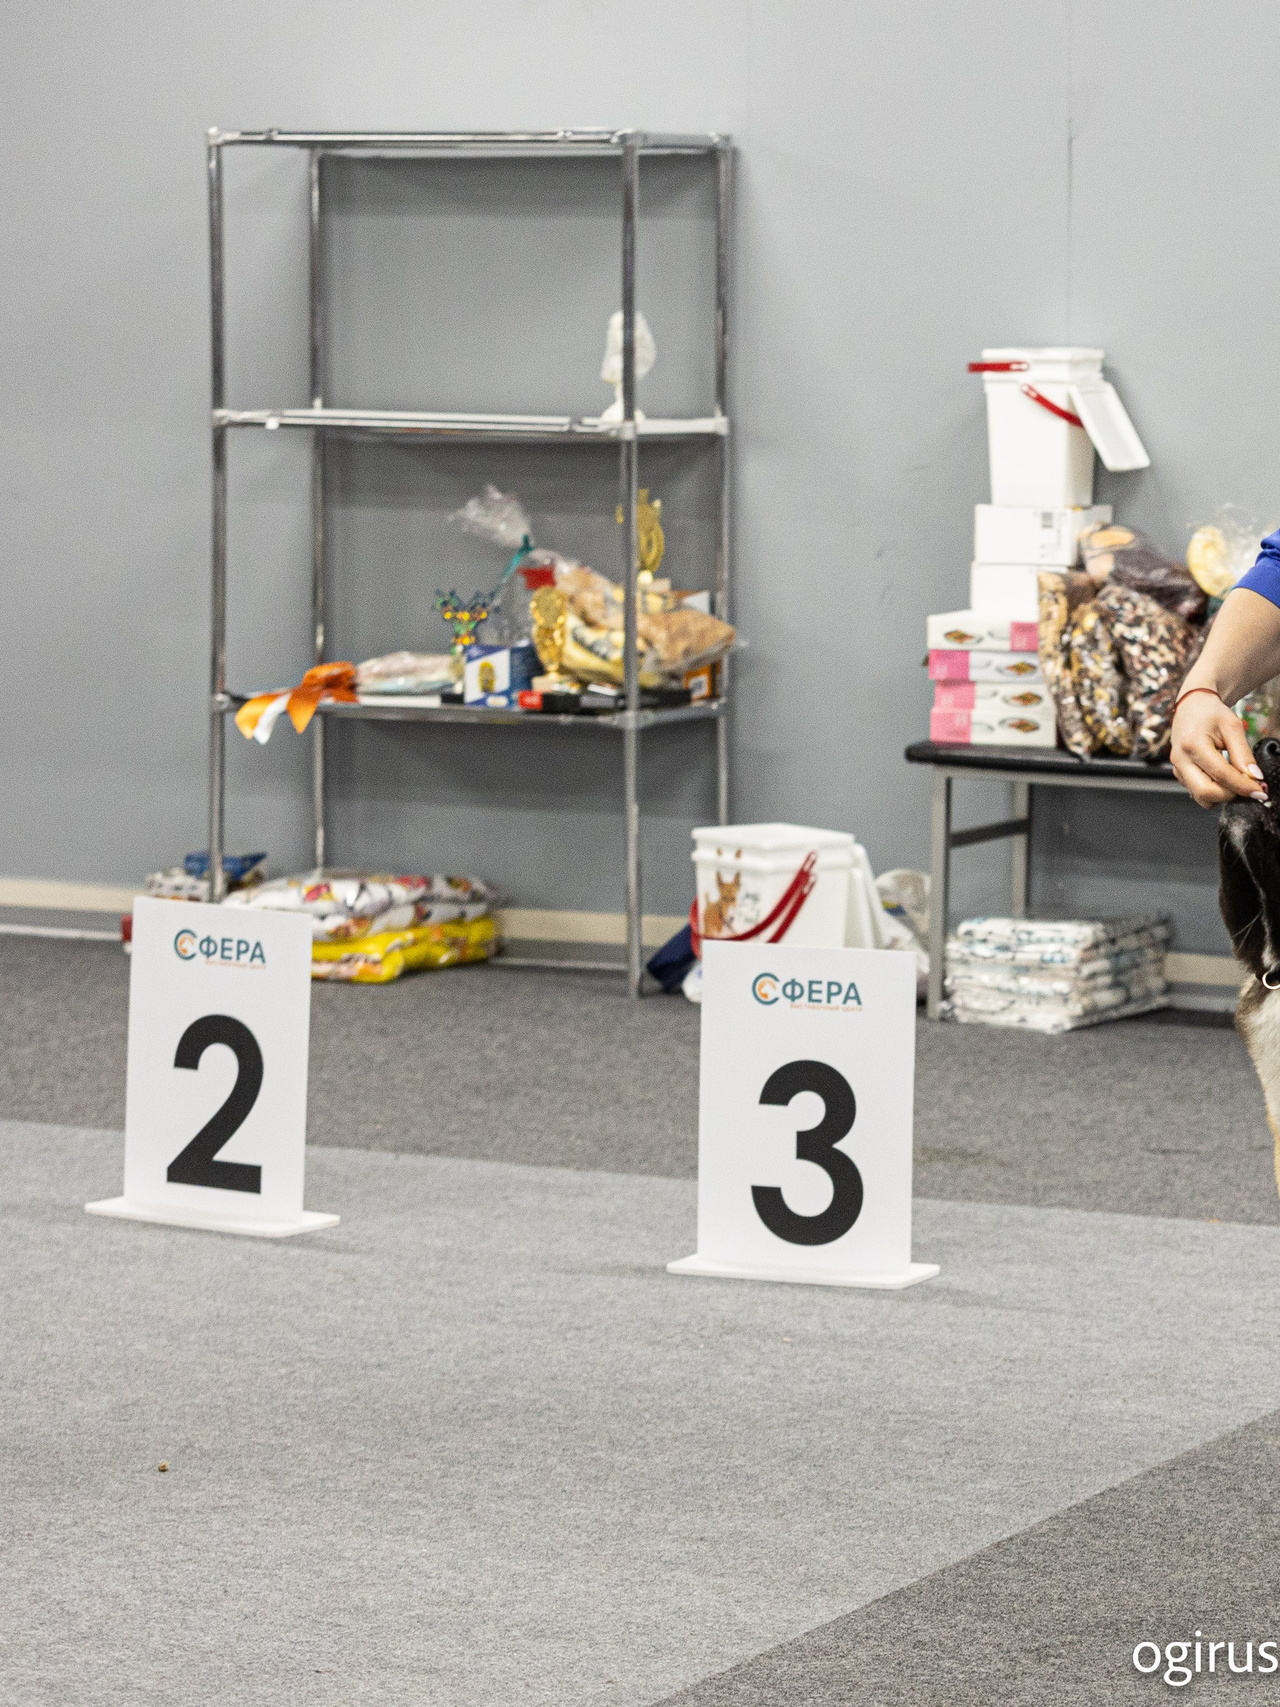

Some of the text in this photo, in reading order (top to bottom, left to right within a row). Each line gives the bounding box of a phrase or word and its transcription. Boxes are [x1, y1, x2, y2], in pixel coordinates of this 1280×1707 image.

[174, 928, 266, 964] СФЕРА
[752, 972, 862, 1005] СФЕРА
[167, 1014, 264, 1194] 2
[751, 1060, 863, 1246] 3
